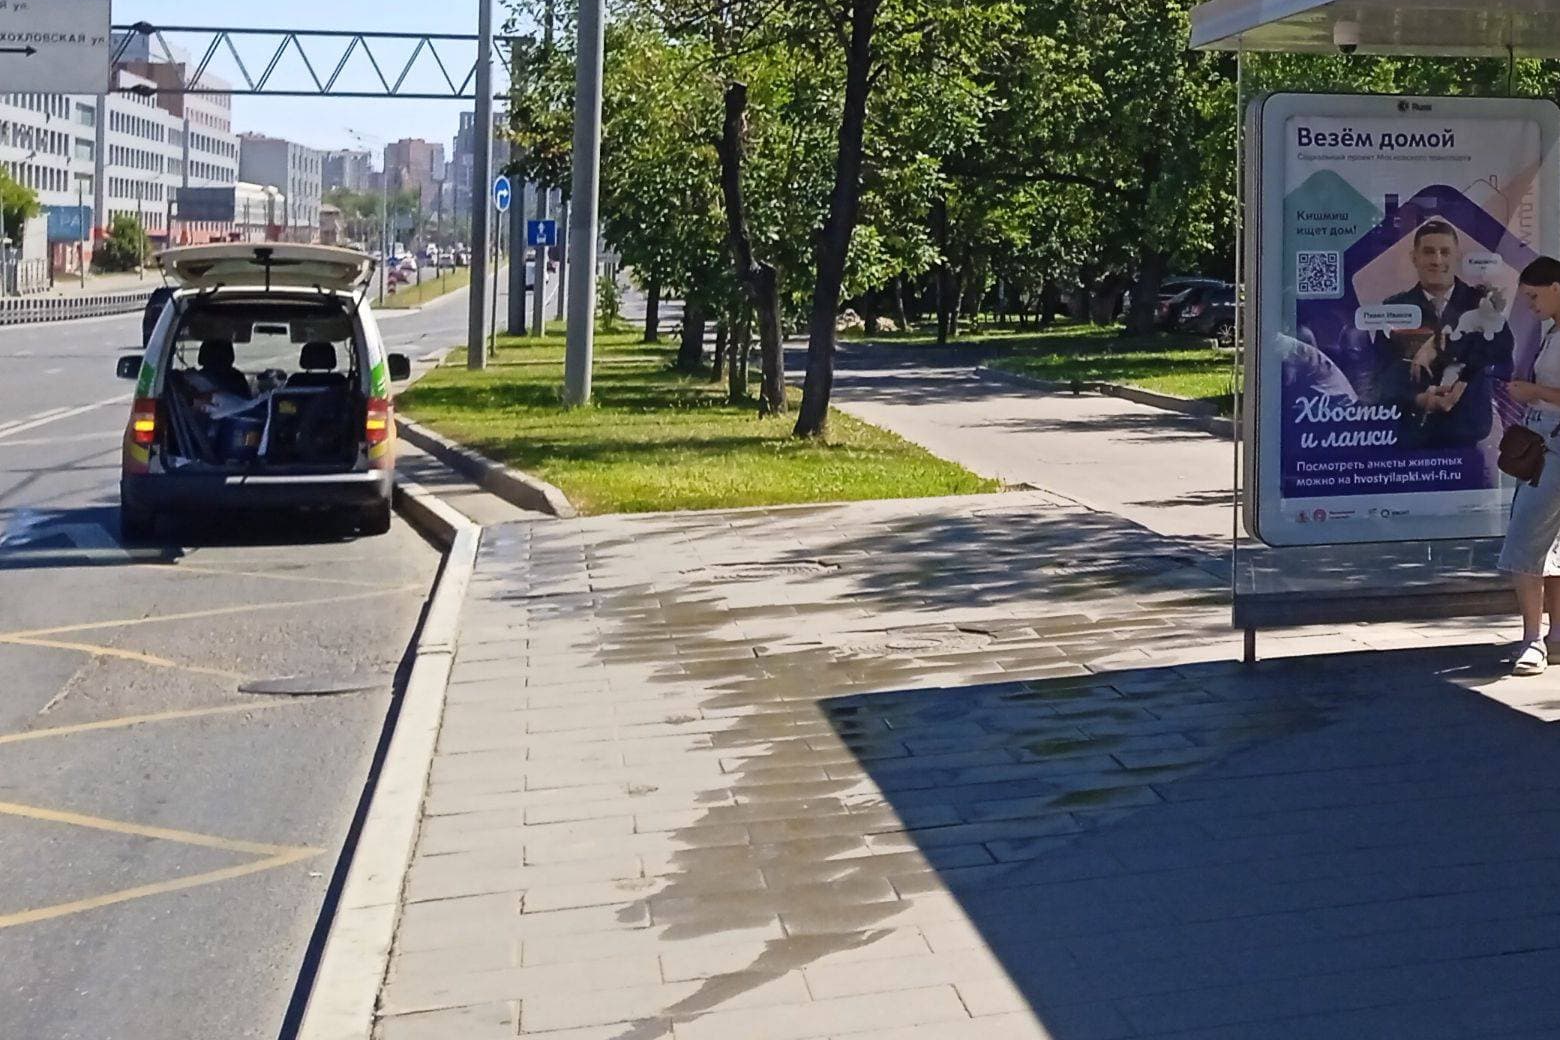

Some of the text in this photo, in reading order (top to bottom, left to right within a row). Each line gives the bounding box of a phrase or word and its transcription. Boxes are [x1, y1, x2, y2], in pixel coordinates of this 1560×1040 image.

[1297, 127, 1455, 150] Везём домой
[1297, 211, 1349, 221] Кишмиш
[1297, 225, 1357, 237] ищет дом!
[1295, 393, 1402, 423] Хвосты
[1301, 429, 1398, 448] и лапки
[1297, 456, 1463, 472] Посмотреть анкеты животных
[1297, 476, 1335, 487] можно
[1338, 477, 1351, 485] на
